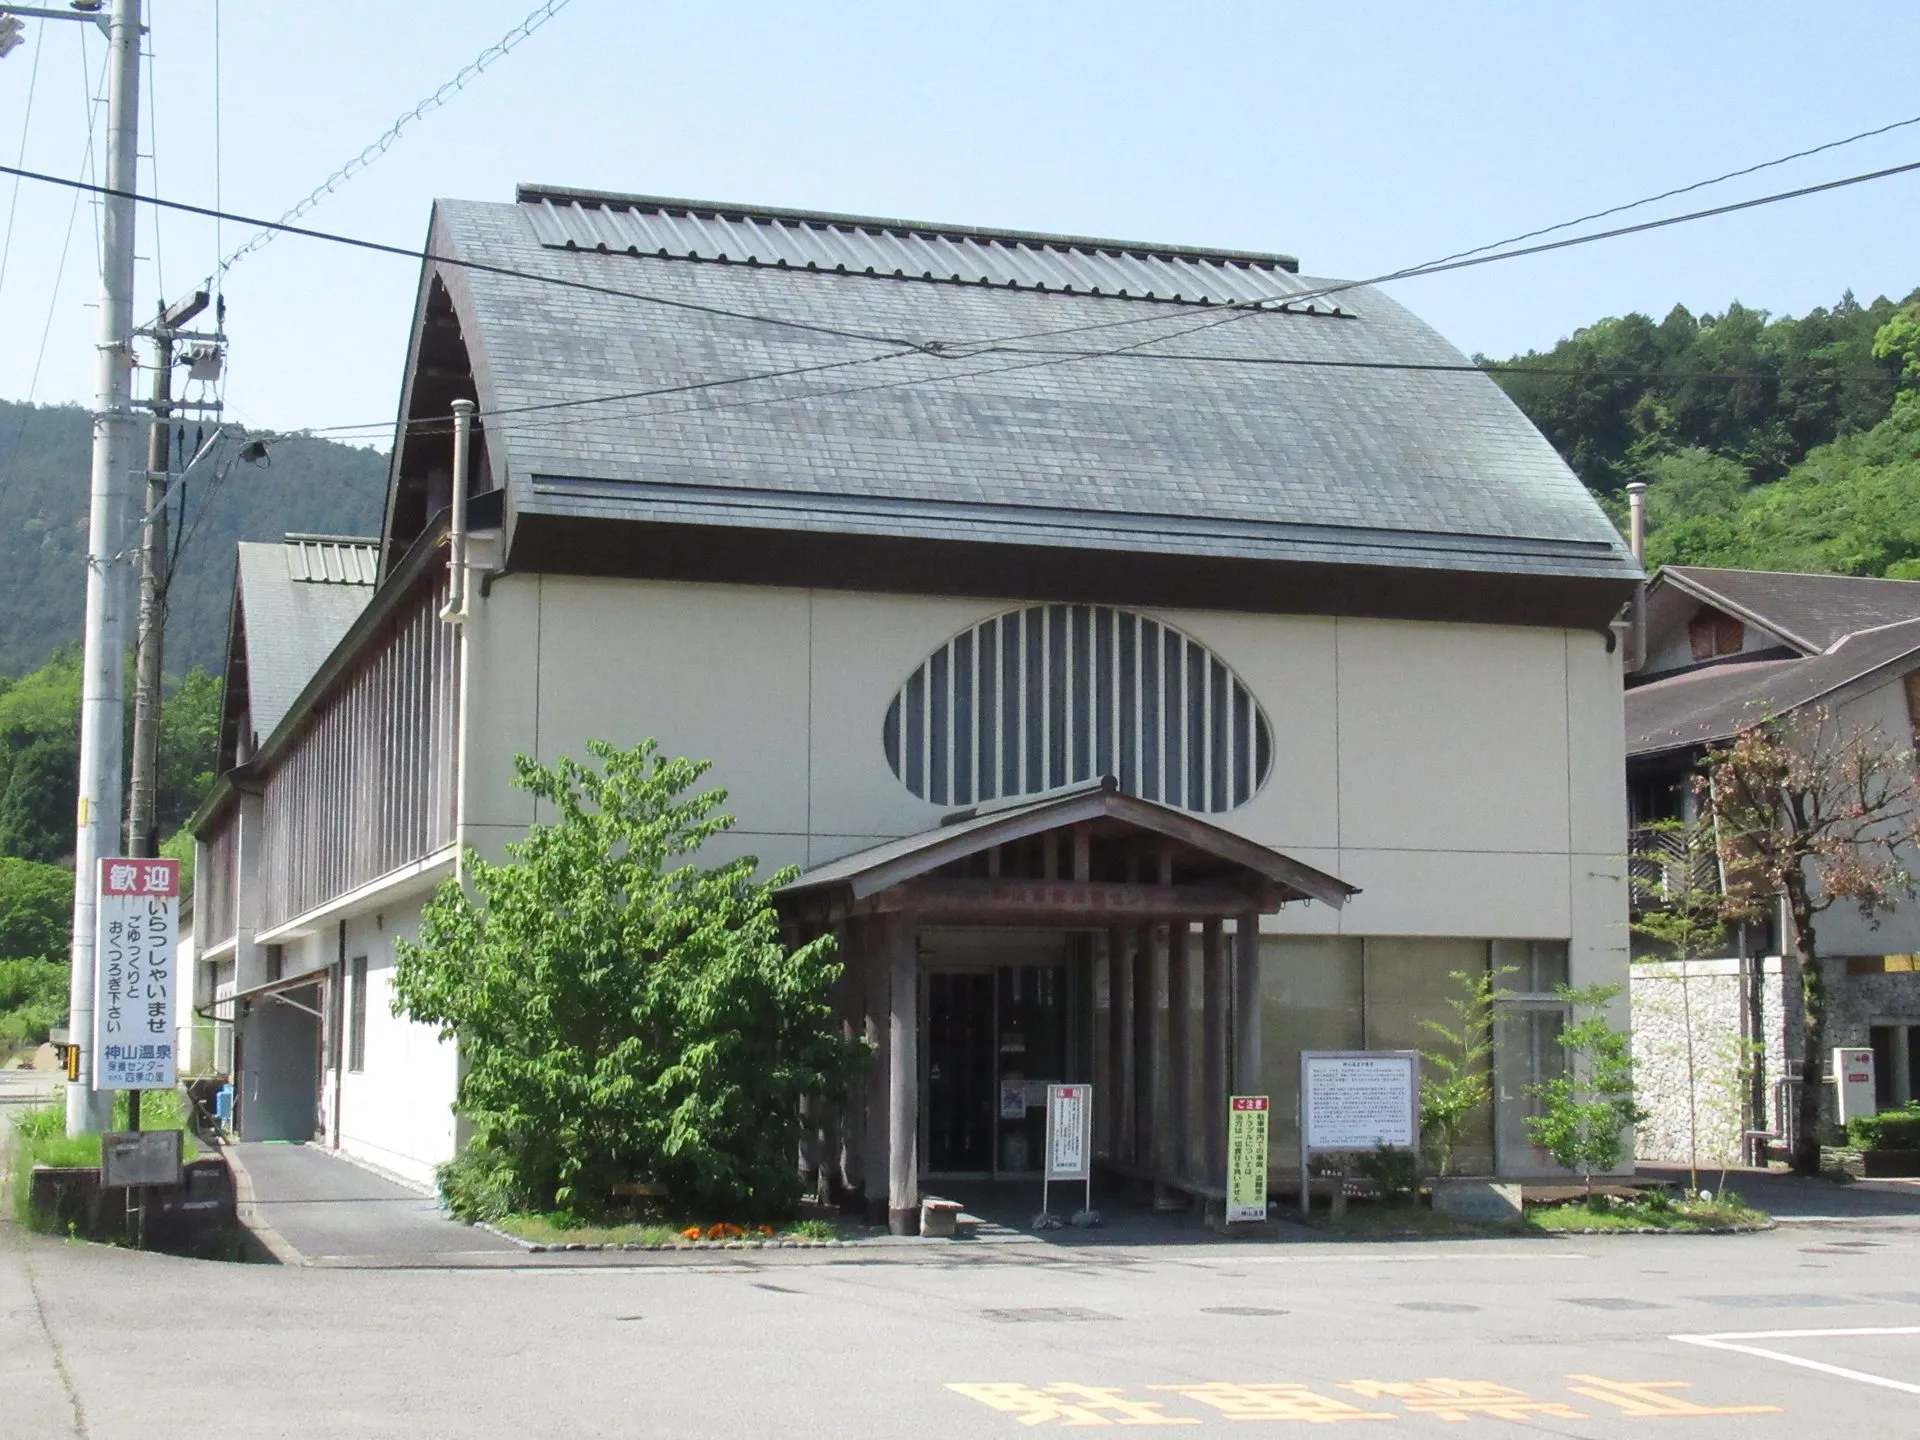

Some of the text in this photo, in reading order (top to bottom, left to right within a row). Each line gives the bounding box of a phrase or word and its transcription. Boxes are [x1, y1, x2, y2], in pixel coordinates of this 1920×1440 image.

[109, 865, 170, 893] 歓迎
[126, 915, 142, 999] ごゆっくりと
[147, 900, 168, 1034] いらっしゃいませ
[107, 921, 124, 1034] おくつろぎ下さい
[104, 1044, 172, 1060] 神山温泉
[108, 1061, 165, 1072] 保養センター
[125, 1072, 165, 1083] 四季の里
[1237, 1099, 1263, 1109] ご注意
[944, 1373, 1785, 1425] 駐車禁止
